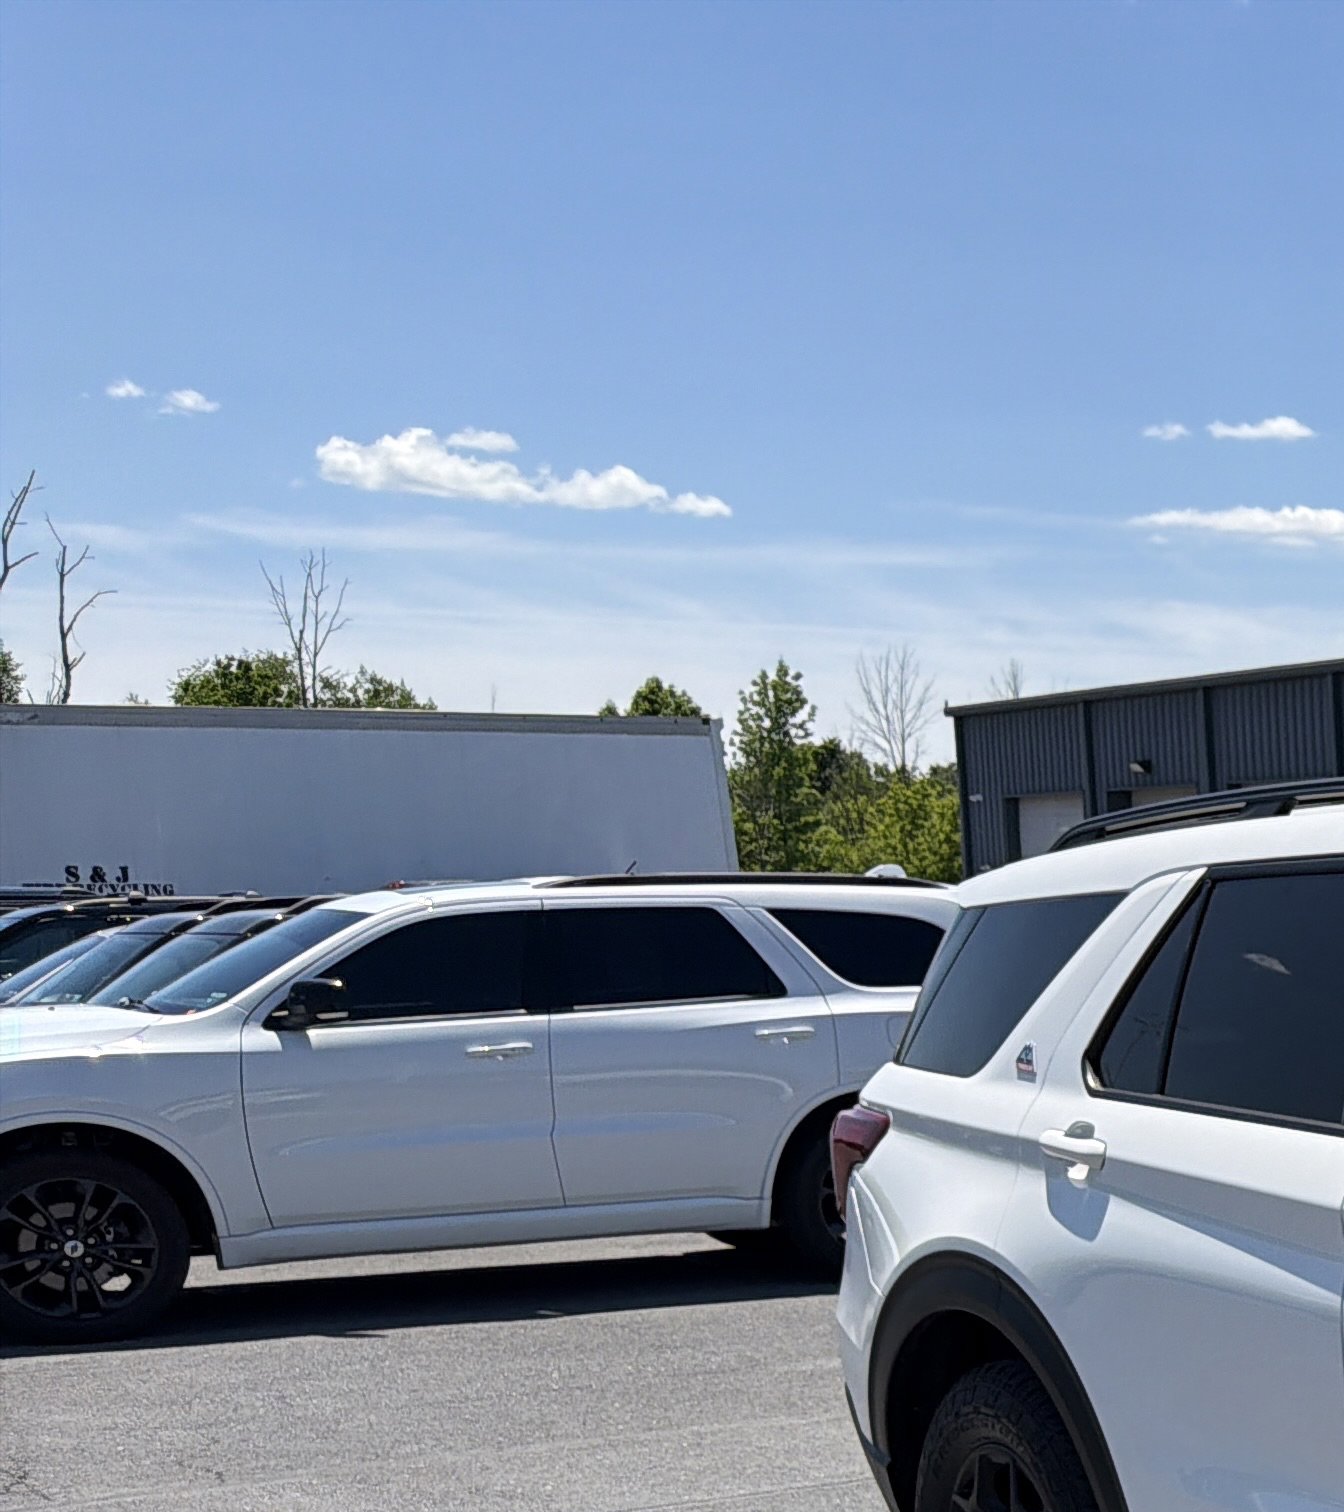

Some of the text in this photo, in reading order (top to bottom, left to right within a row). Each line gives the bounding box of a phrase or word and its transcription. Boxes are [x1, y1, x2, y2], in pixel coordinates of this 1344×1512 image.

[64, 865, 129, 883] S & J
